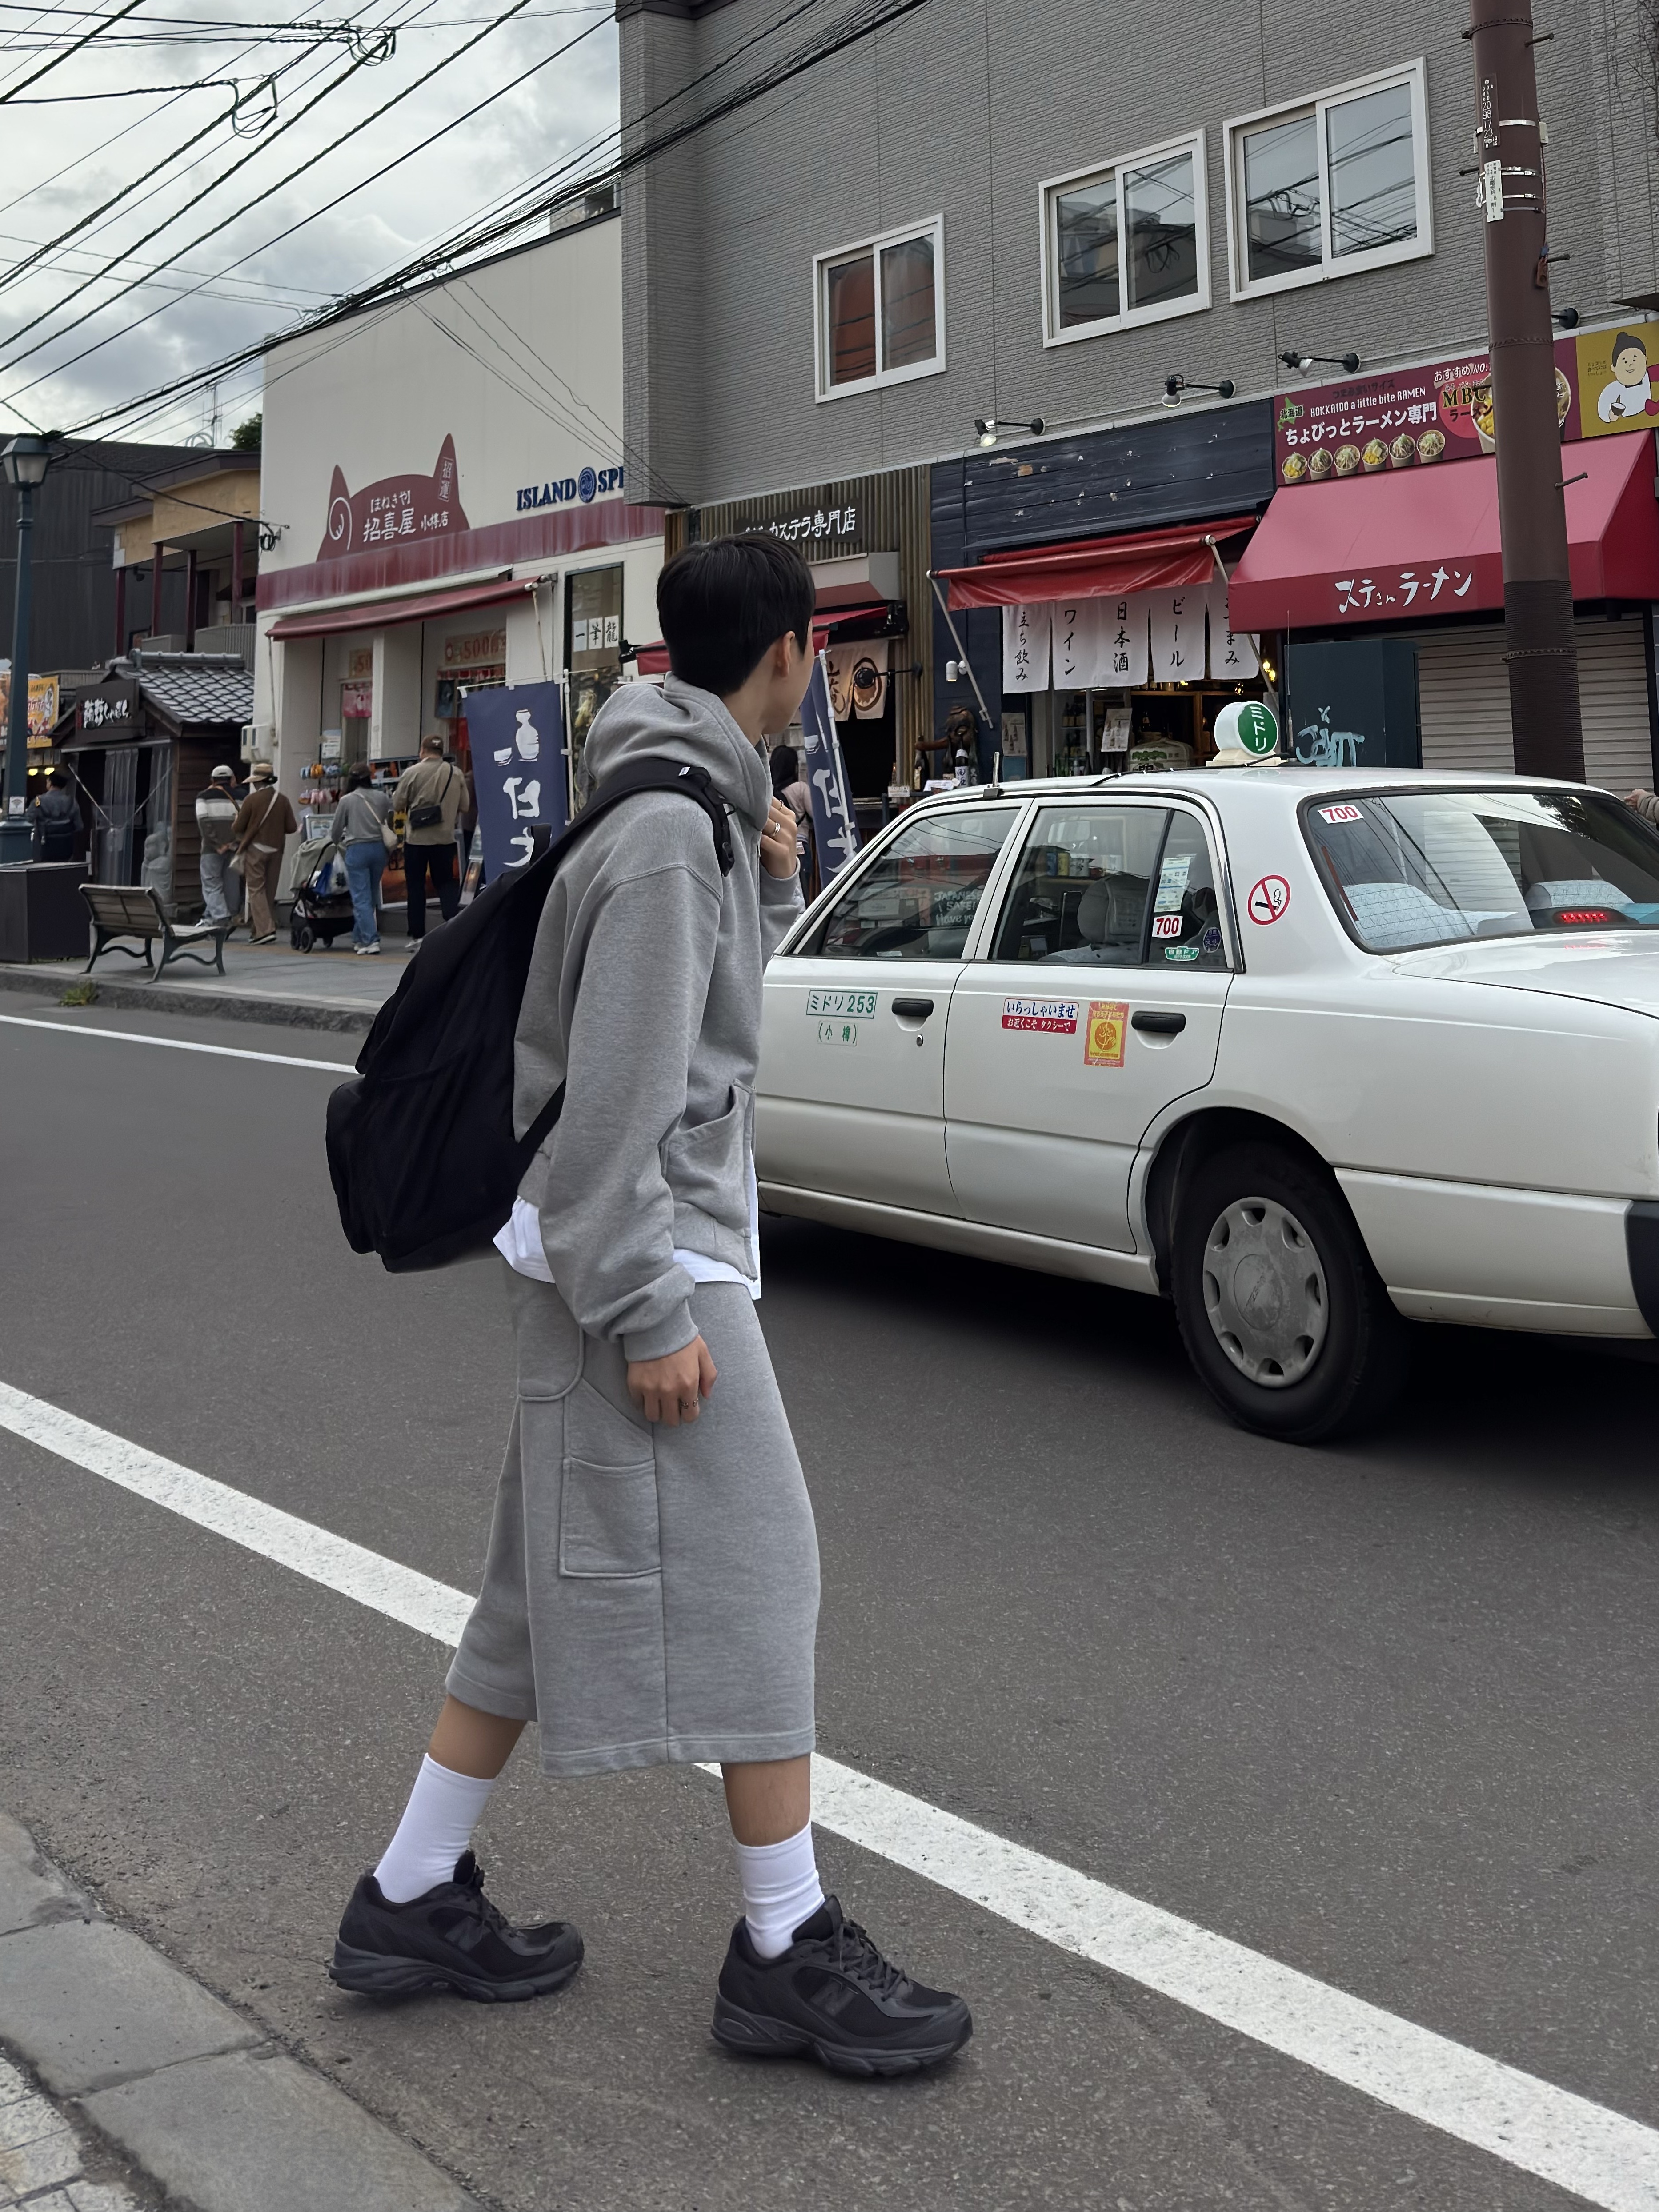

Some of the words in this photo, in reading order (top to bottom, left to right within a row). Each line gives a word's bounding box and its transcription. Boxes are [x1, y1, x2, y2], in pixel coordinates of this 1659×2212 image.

[1482, 101, 1491, 111] 20
[1483, 110, 1491, 119] 98
[1484, 120, 1492, 128] 17
[1484, 128, 1493, 138] 23
[1435, 364, 1471, 382] おすすめ
[1310, 401, 1349, 417] HOKKAIDO
[1357, 397, 1377, 409] little
[1379, 393, 1395, 404] bite
[1397, 386, 1426, 401] RAMEN
[1443, 387, 1486, 408] MBC
[1280, 405, 1304, 420] 北海道
[1286, 401, 1438, 446] ちょびっとラーメン専門
[516, 478, 577, 511] ISLAND
[363, 507, 417, 542] 招喜屋
[421, 511, 449, 532] 小樽店
[769, 506, 856, 540] カステラ専門店
[1113, 601, 1130, 673] 日本酒
[1170, 597, 1186, 667] ビール
[1014, 611, 1030, 681] 立ち飲み
[1063, 609, 1077, 676] ワイン
[1250, 706, 1266, 751] ミドリ
[1322, 806, 1358, 821] 700
[1156, 917, 1179, 935] 700
[810, 995, 844, 1011] ミドリ
[846, 995, 874, 1014] 253
[1007, 1001, 1075, 1018] いらっしゃいませ
[1041, 1021, 1070, 1031] タクシーで
